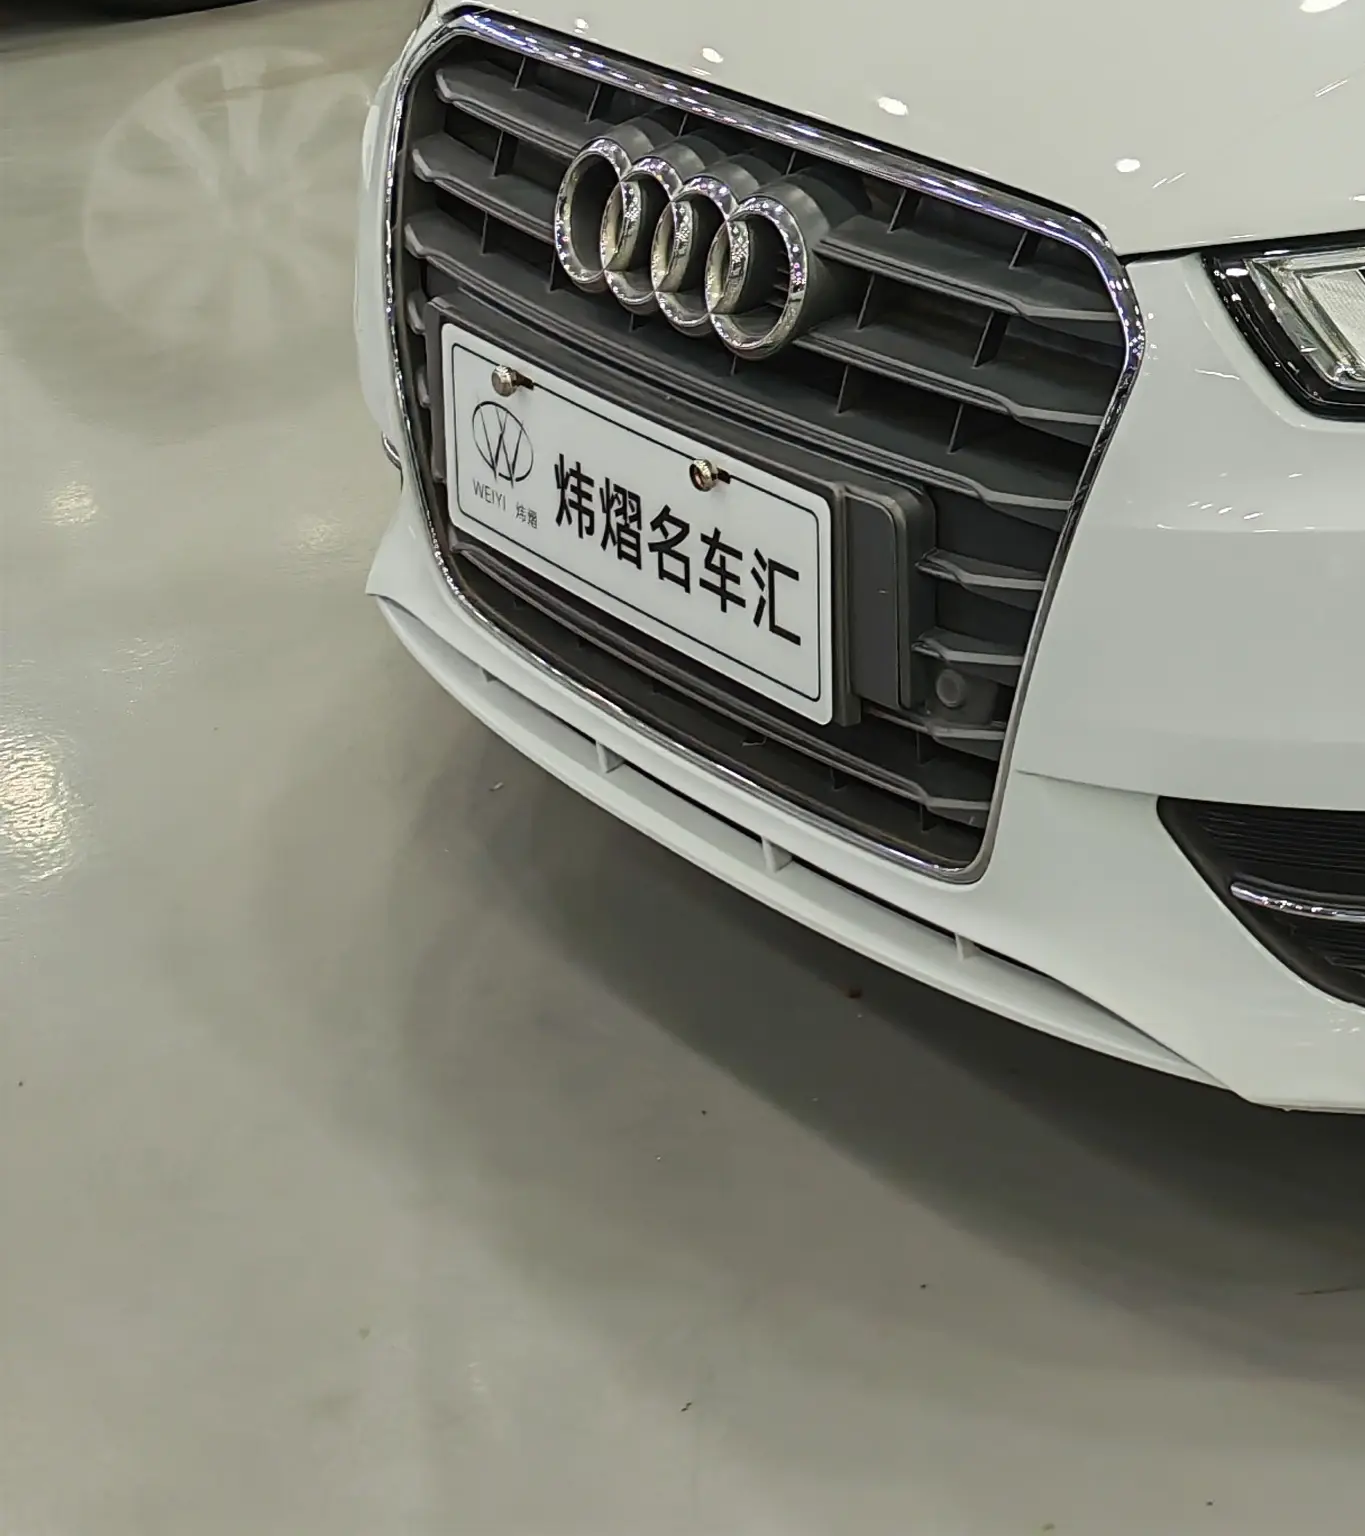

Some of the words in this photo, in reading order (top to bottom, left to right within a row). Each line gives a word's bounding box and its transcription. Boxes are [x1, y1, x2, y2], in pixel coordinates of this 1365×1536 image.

[472, 477, 507, 512] WEIYI
[553, 452, 802, 647] 炜熠名车汇
